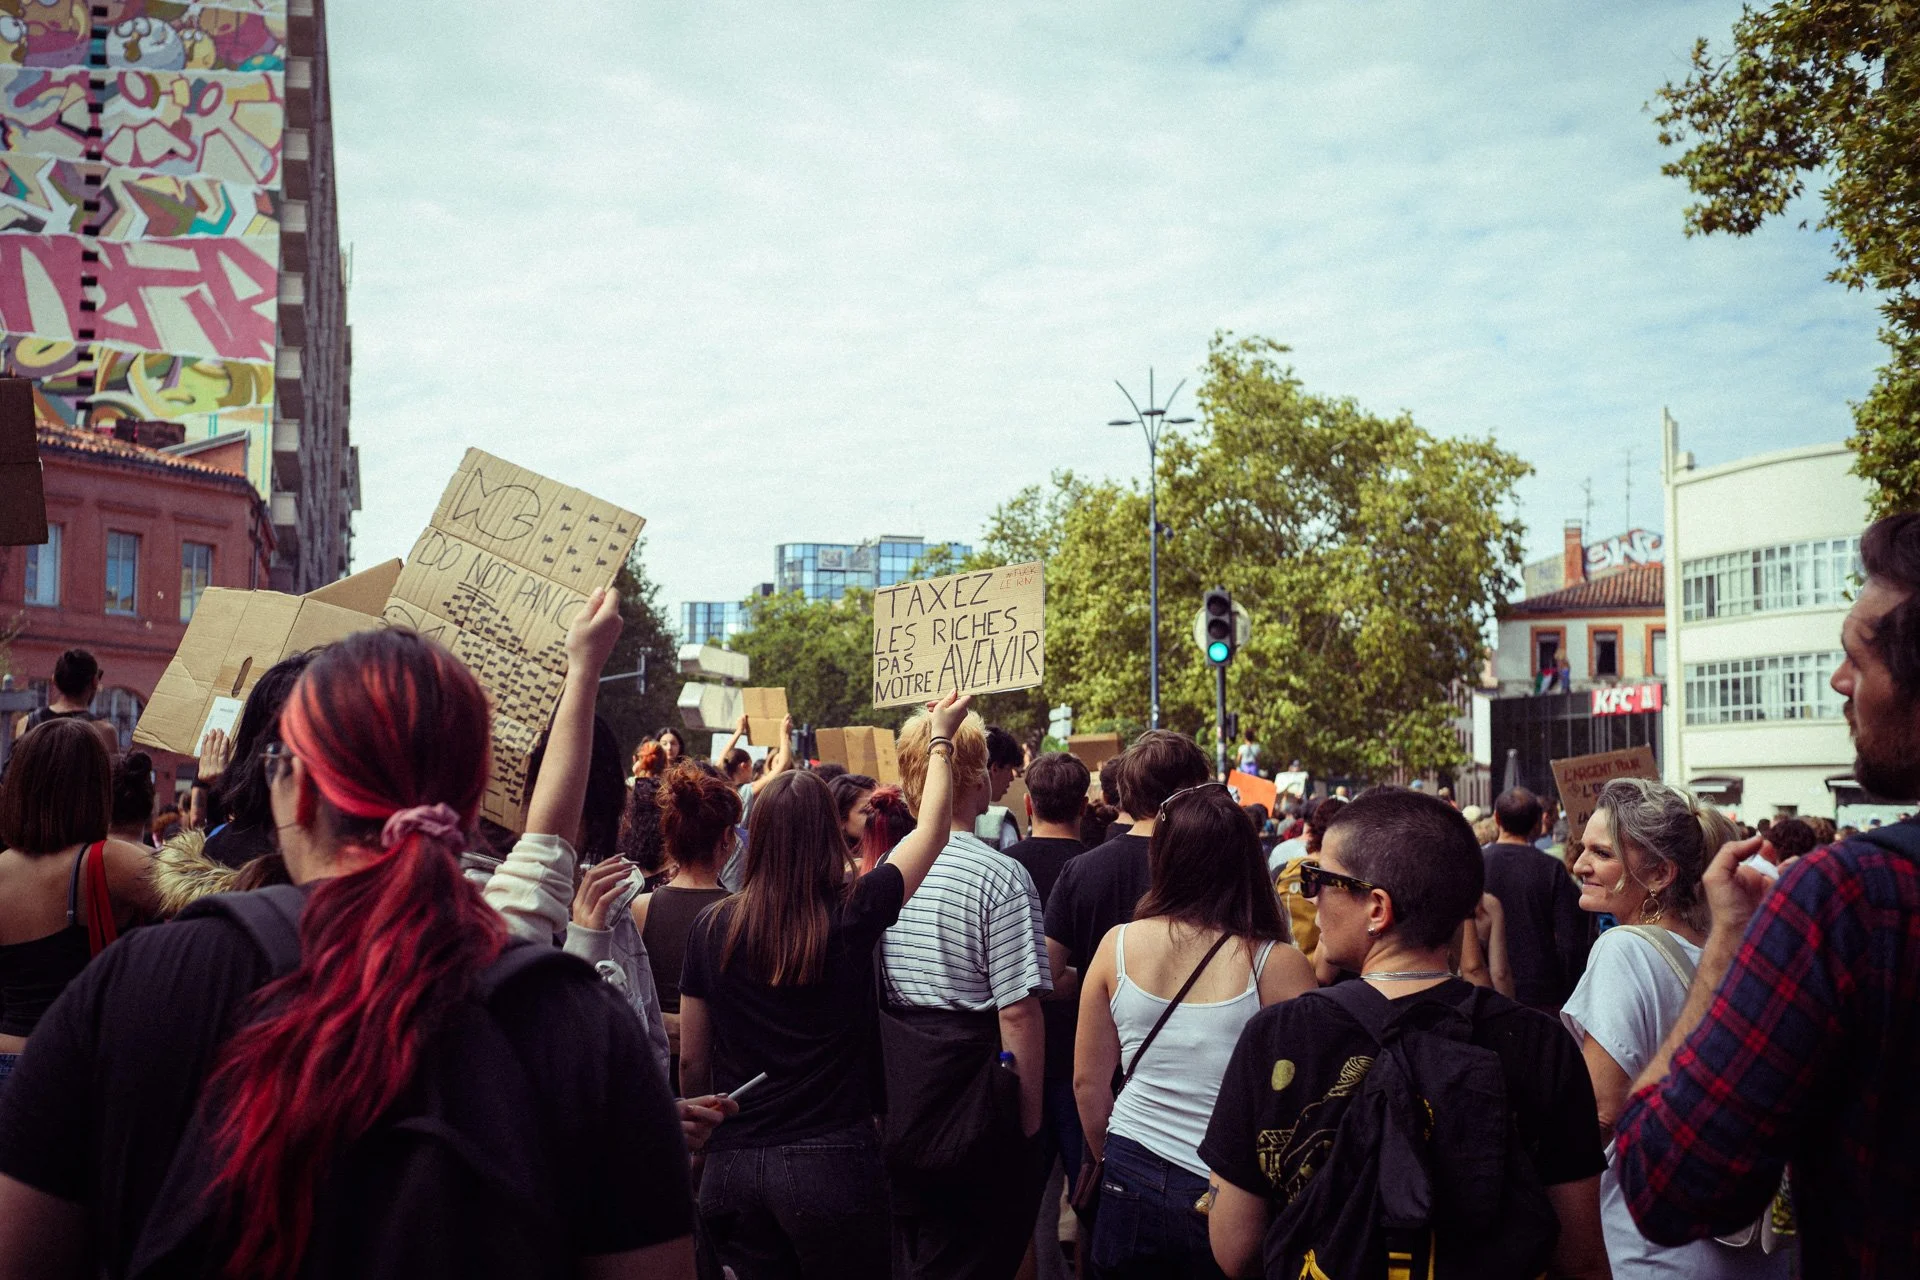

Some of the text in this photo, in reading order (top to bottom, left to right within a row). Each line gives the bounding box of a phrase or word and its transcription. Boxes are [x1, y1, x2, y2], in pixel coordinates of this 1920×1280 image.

[417, 530, 587, 632] DO NOT PANIC
[878, 572, 994, 618] TAXEZ
[874, 606, 1017, 656] LES RICHES
[875, 630, 1039, 703] NOTRE AVENIR
[878, 652, 914, 677] PAS
[1592, 686, 1635, 715] KFC
